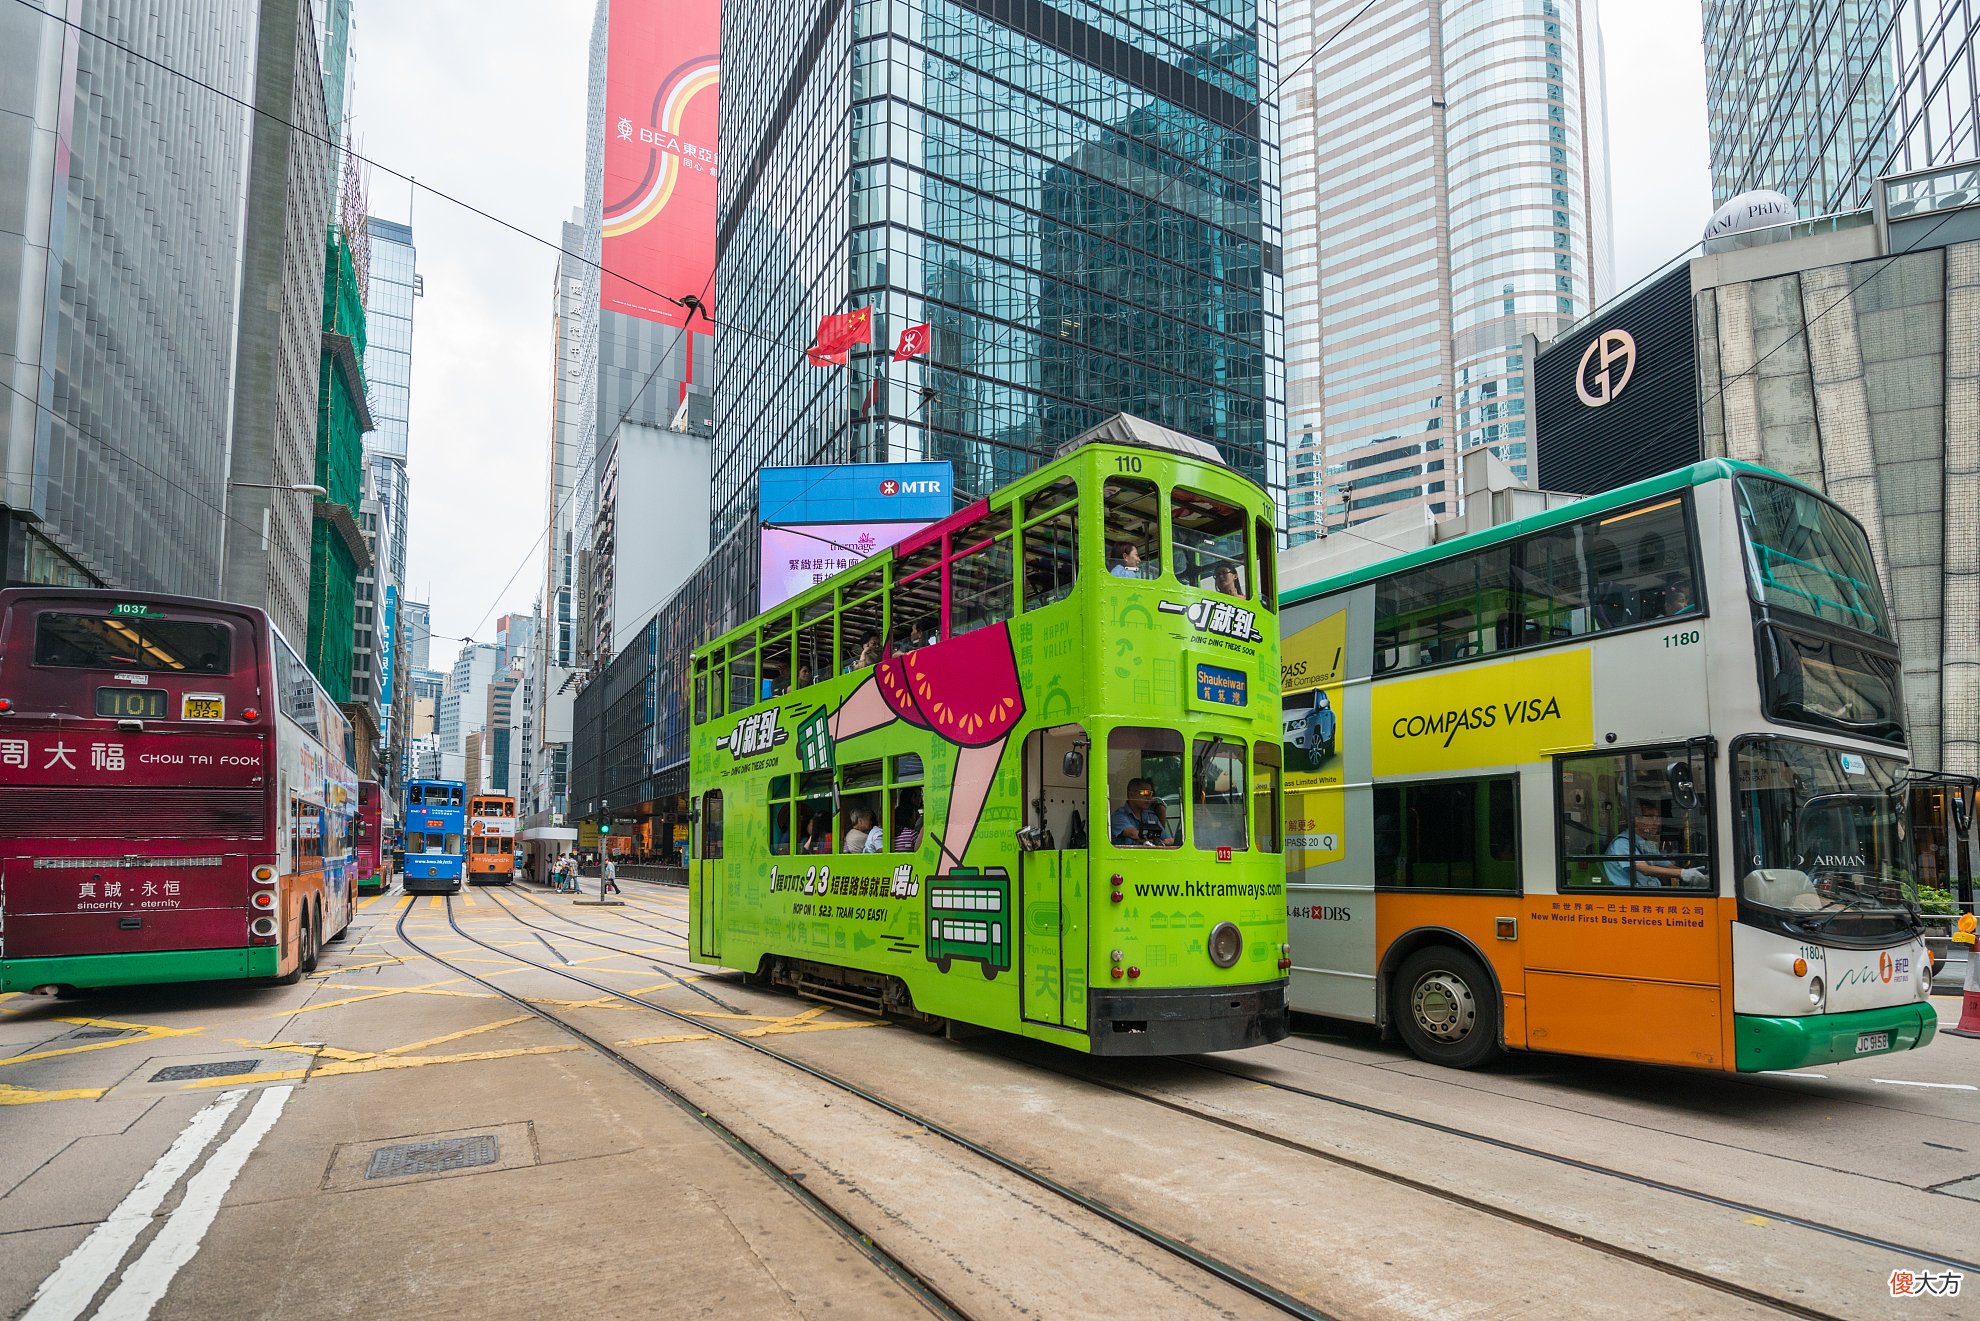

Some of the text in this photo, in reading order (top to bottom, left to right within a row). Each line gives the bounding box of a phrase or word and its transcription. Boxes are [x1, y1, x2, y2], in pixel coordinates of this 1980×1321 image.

[640, 127, 681, 153] BEA
[683, 157, 704, 172] 同心
[1115, 455, 1142, 473] 110
[902, 480, 942, 494] MTR
[118, 604, 147, 614] 1037
[1043, 619, 1070, 641] HAPPY
[1190, 635, 1207, 645] DING
[1207, 638, 1223, 649] DING
[1663, 630, 1700, 649] 1180
[1019, 621, 1034, 690] 跑馬地
[1043, 638, 1073, 660] VALLEY
[1197, 670, 1246, 691] Shaukeiwan
[1293, 673, 1329, 687] Compass
[114, 694, 156, 716] 101
[195, 701, 212, 711] HX
[189, 710, 219, 719] 1323
[1392, 693, 1562, 749] COMPASS VISA
[0, 738, 125, 771] 周大福
[139, 753, 261, 766] CHOW TAI FOOK
[1296, 778, 1318, 786] Limited
[1319, 776, 1337, 784] White
[1308, 837, 1319, 847] 20
[1218, 850, 1231, 859] 013
[79, 880, 180, 898] 真誠 永恒
[1134, 880, 1282, 900] www.hktramways.com
[77, 899, 180, 910] sincerity eternity
[793, 903, 804, 915] HOP
[804, 904, 812, 916] ON
[836, 907, 854, 919] TRAM
[855, 908, 866, 919] SO
[1552, 903, 1704, 916] 新世界第一巴士服務有限公司
[1323, 907, 1351, 921] DBS
[1531, 912, 1704, 928] New World First Bus Services Limited
[1027, 944, 1056, 955] Tin Hau
[1800, 946, 1820, 959] 1180
[1895, 958, 1909, 973] 新巴
[1035, 964, 1085, 1004] 天后
[1858, 1034, 1887, 1051] JC 9158
